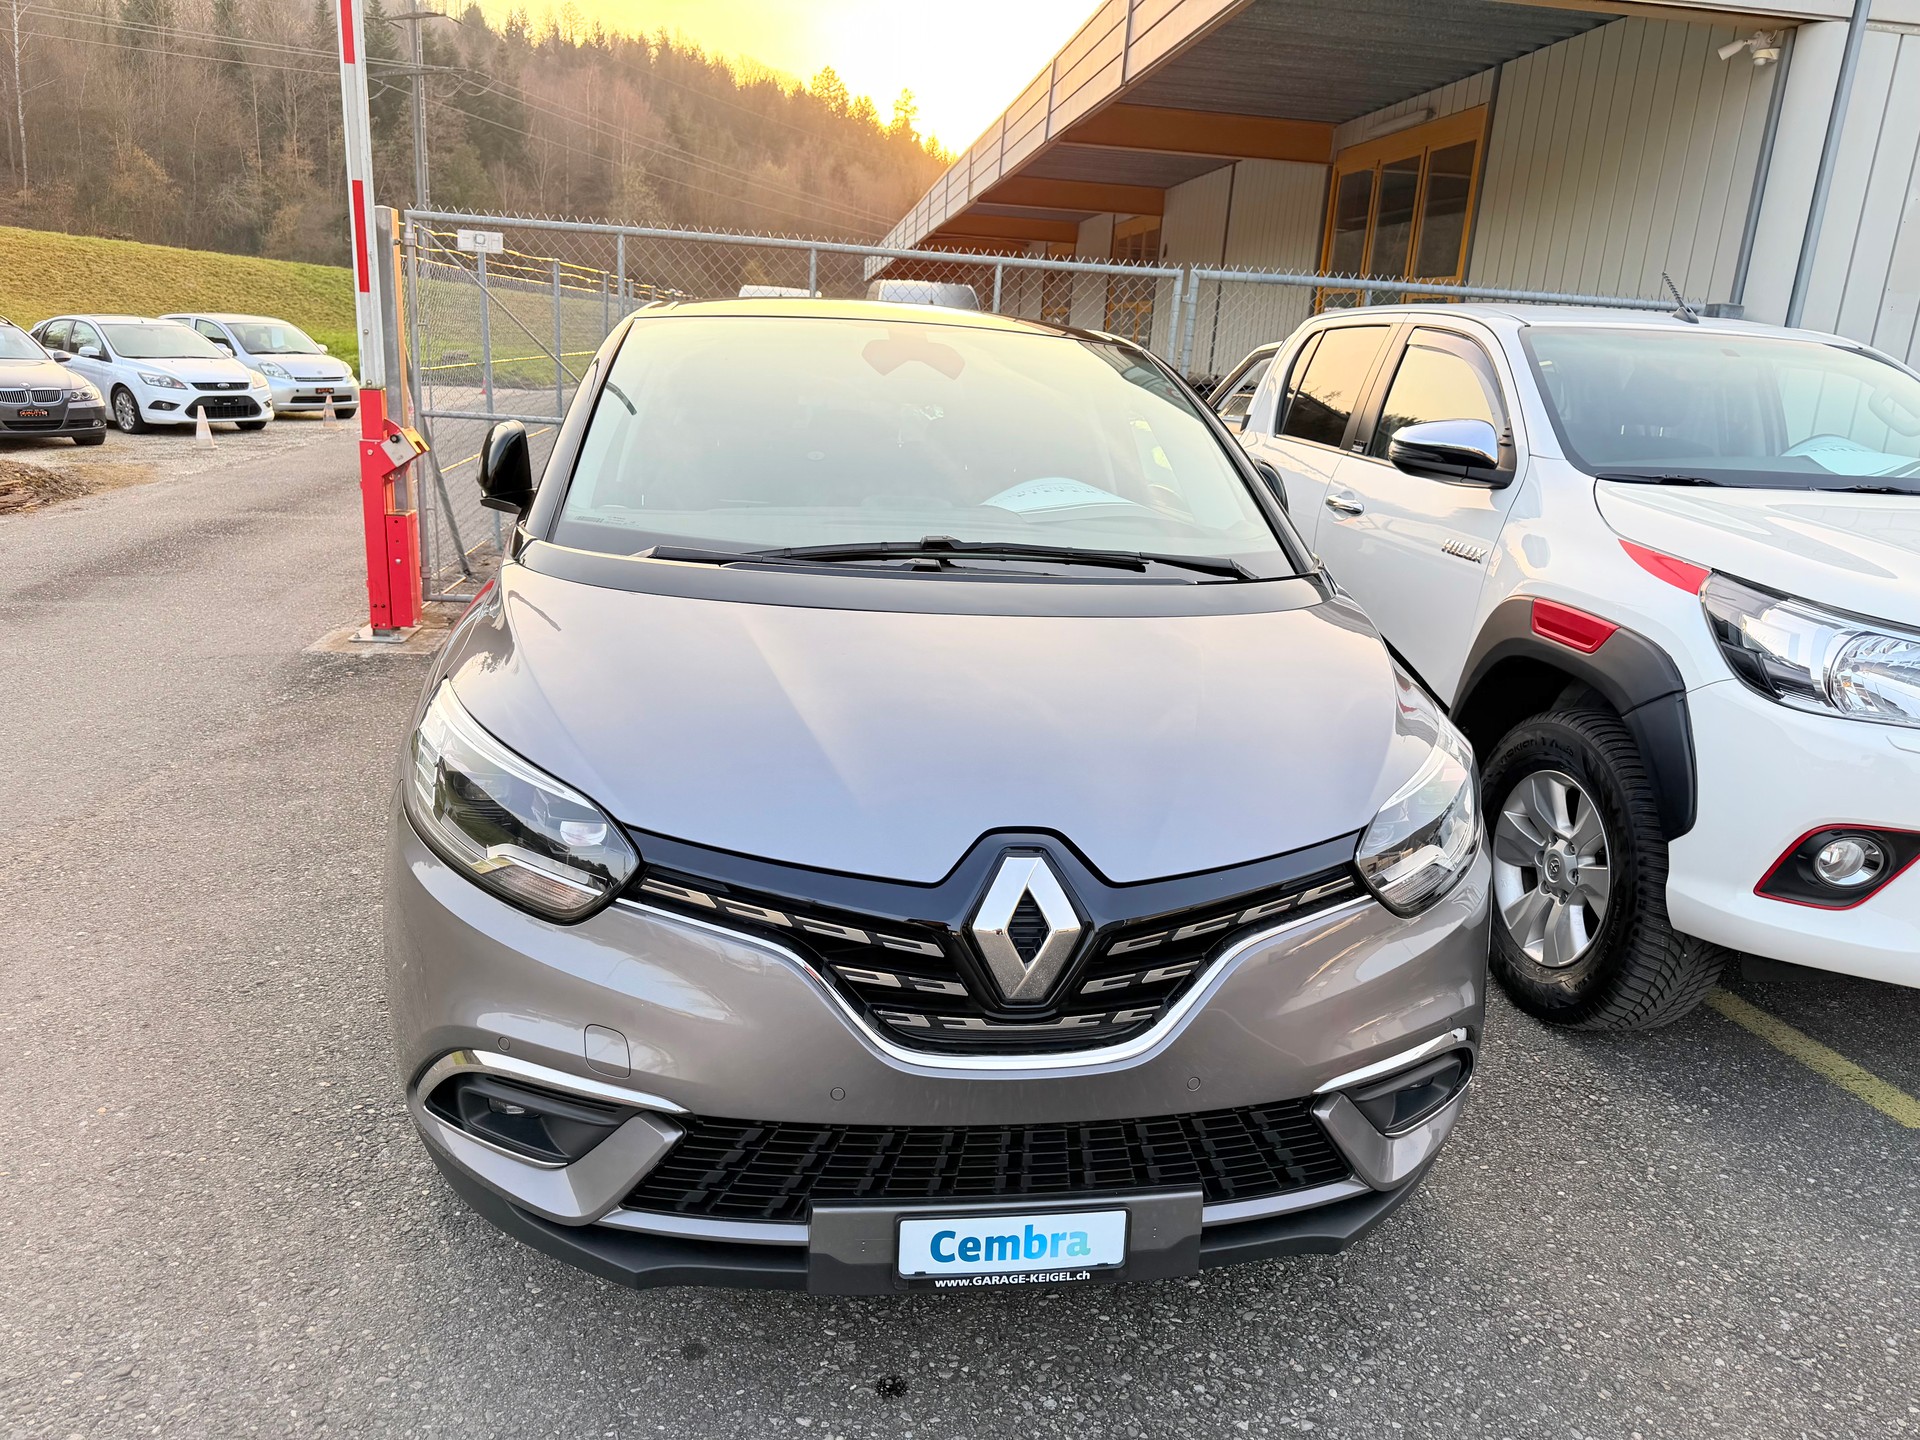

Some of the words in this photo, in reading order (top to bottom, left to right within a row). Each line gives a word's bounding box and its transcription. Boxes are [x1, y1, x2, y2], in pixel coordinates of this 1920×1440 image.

[1441, 539, 1488, 564] HILUX
[930, 1224, 1091, 1263] Cembra
[935, 1270, 1091, 1288] www.GARAGE-KEIGEL.ch
